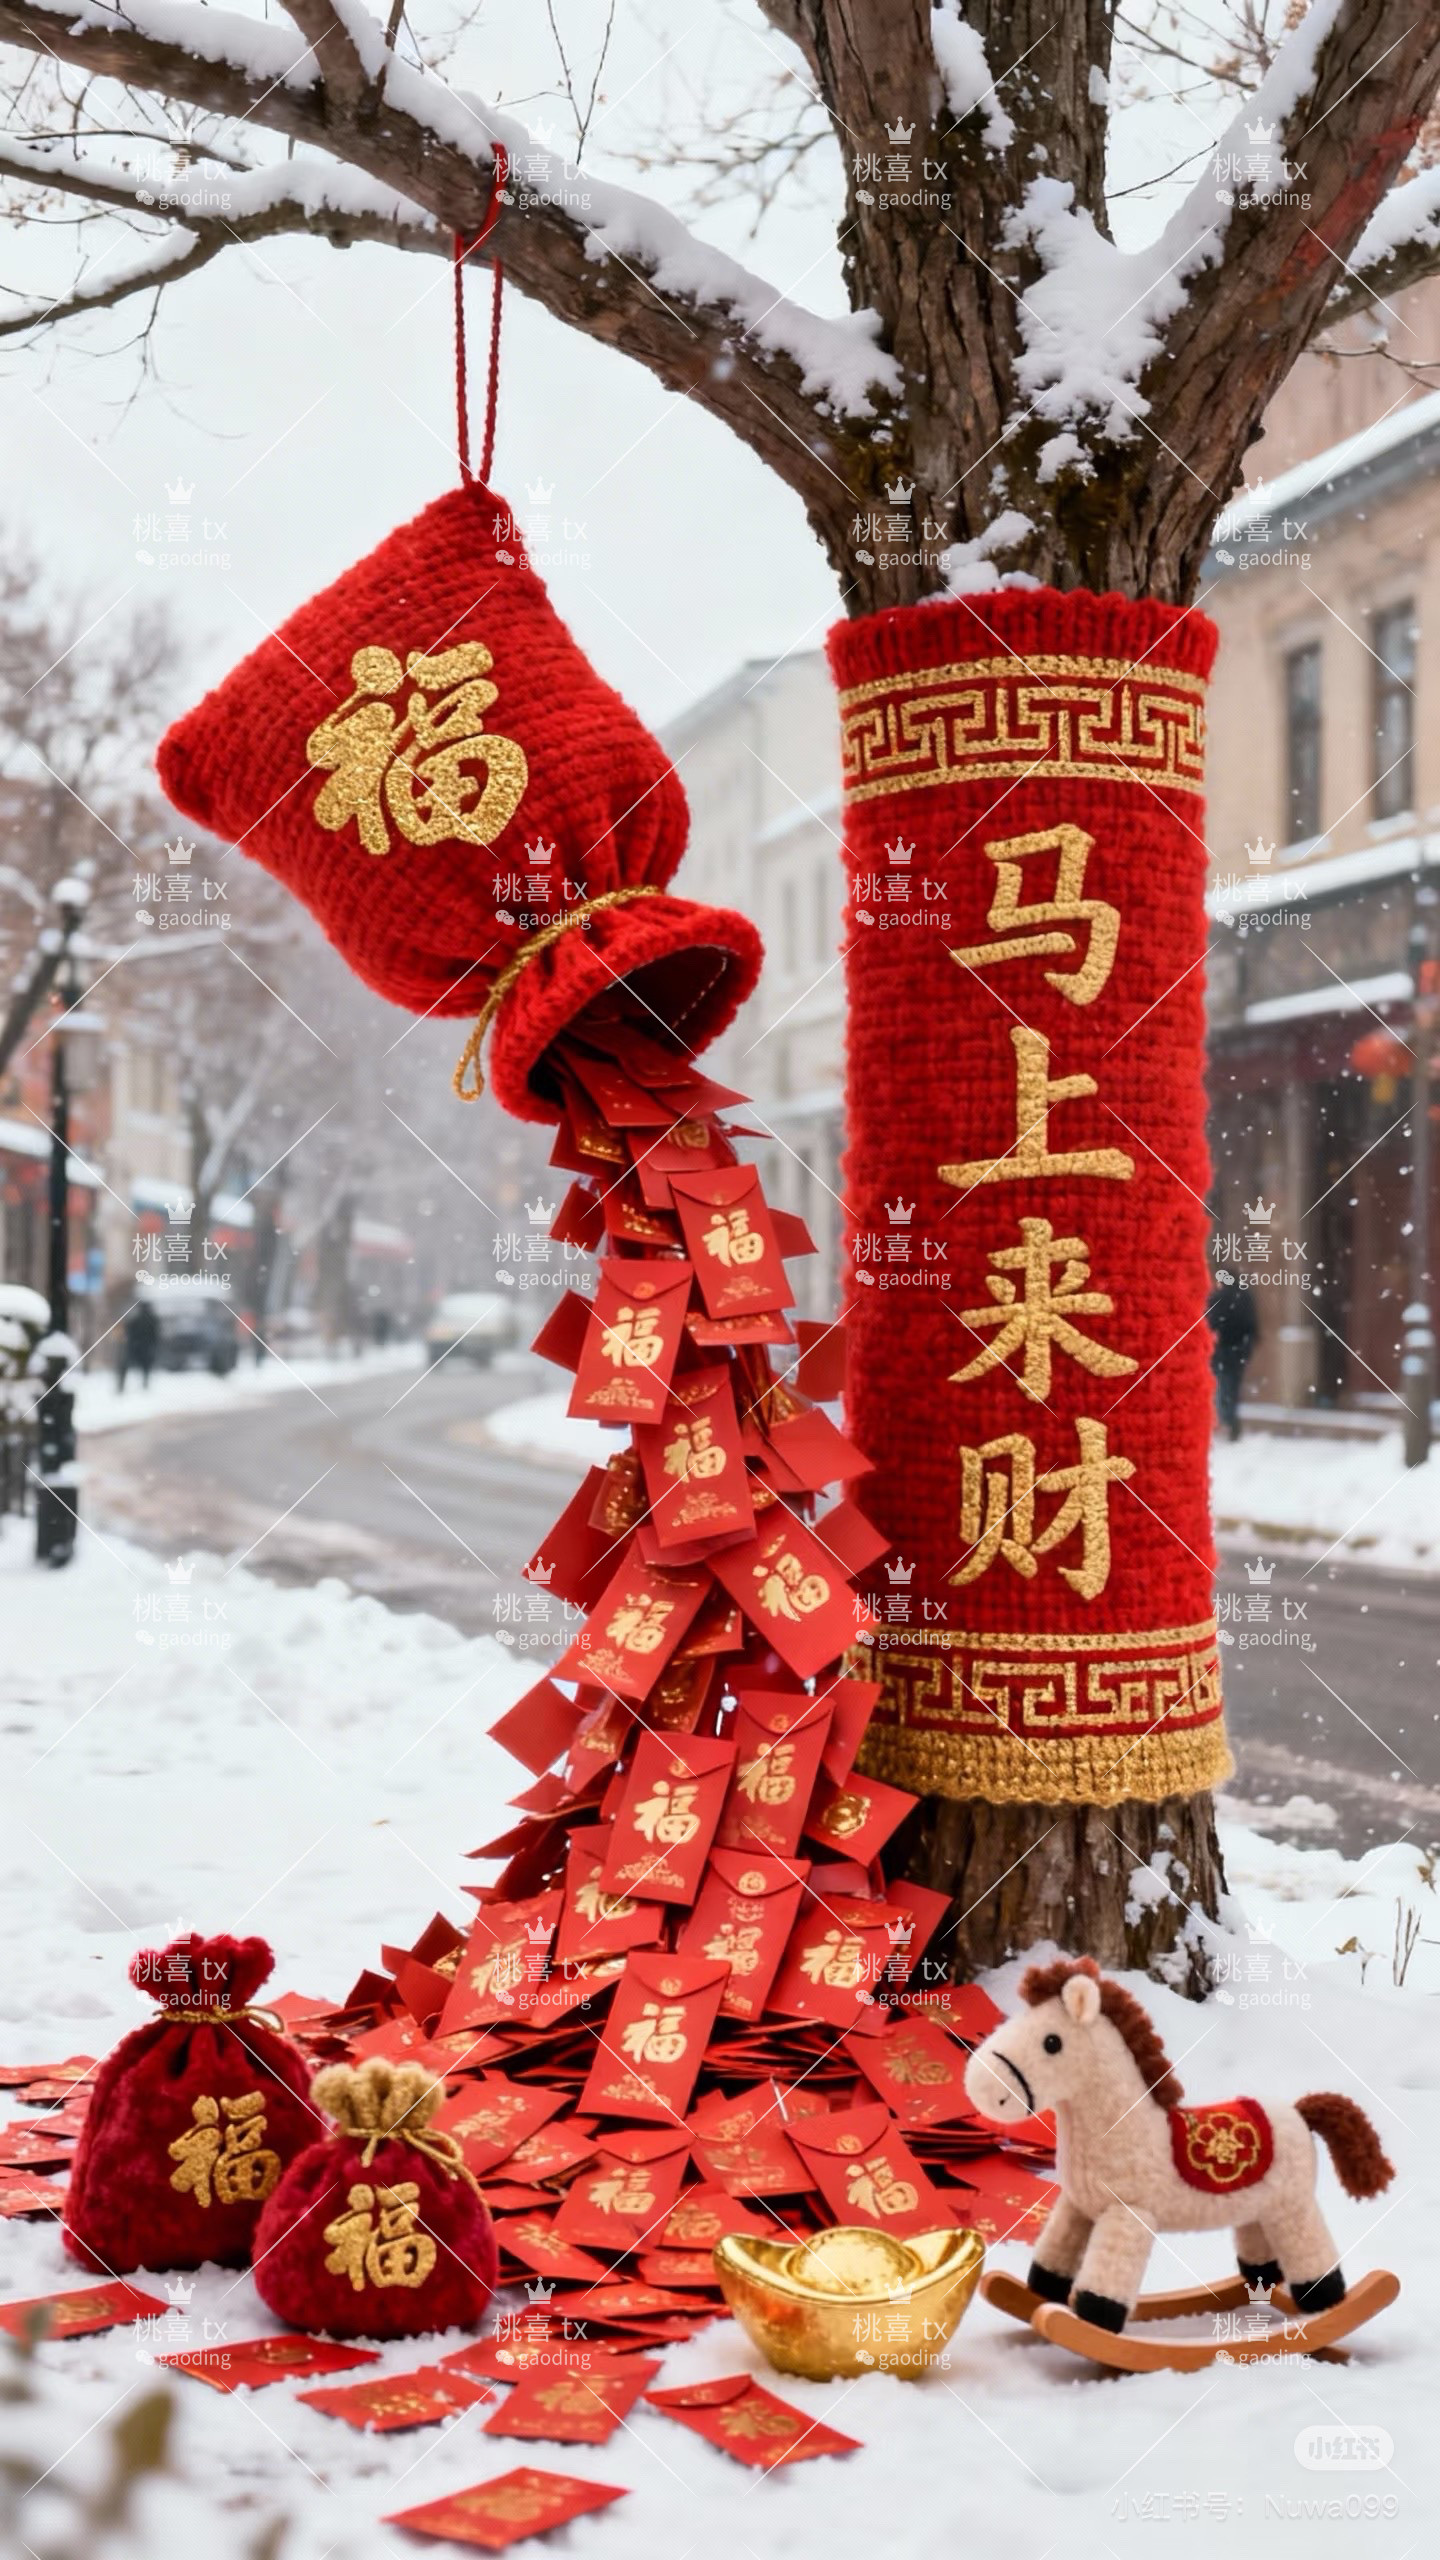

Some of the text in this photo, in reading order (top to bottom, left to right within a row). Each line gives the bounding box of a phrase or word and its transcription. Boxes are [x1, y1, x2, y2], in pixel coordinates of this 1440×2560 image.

[306, 640, 529, 856] 福
[702, 1208, 764, 1267] 福
[938, 823, 1139, 1600] 马上来财
[601, 1306, 664, 1367] 福
[663, 1416, 727, 1482] 福
[605, 1593, 674, 1654] 福
[737, 1743, 796, 1804] 福
[633, 1780, 700, 1844] 福
[621, 2003, 687, 2063] 福
[168, 2091, 281, 2208] 福
[588, 2168, 656, 2214] 福
[847, 2156, 919, 2219] 福
[323, 2182, 437, 2291] 福
